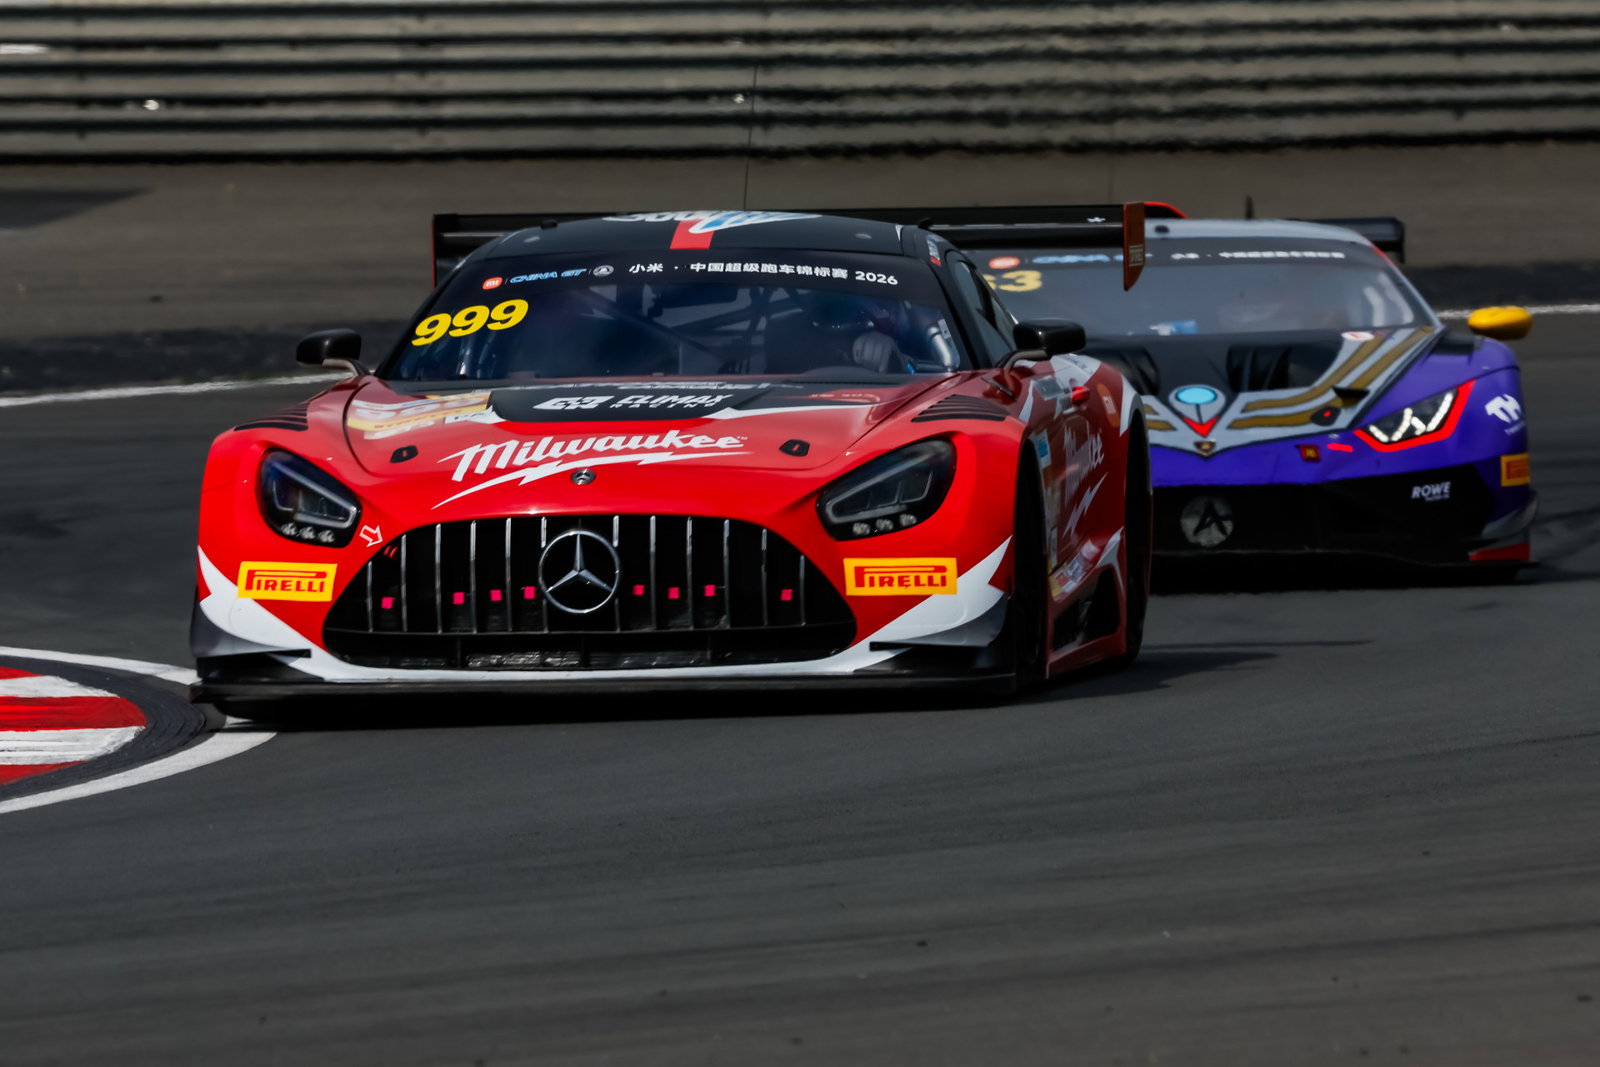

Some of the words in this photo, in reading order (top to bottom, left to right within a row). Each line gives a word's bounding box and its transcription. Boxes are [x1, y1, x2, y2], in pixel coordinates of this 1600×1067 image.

[510, 271, 557, 284] CHINA
[561, 268, 587, 278] GT
[628, 263, 664, 274] 小米
[690, 262, 849, 279] 中国超级跑车锦标赛
[855, 270, 899, 286] 2026
[411, 299, 529, 347] 999
[436, 430, 746, 482] Milwaukee
[1411, 481, 1452, 499] ROWE
[244, 569, 328, 593] PIRELLI
[853, 565, 948, 588] PIRELLI
